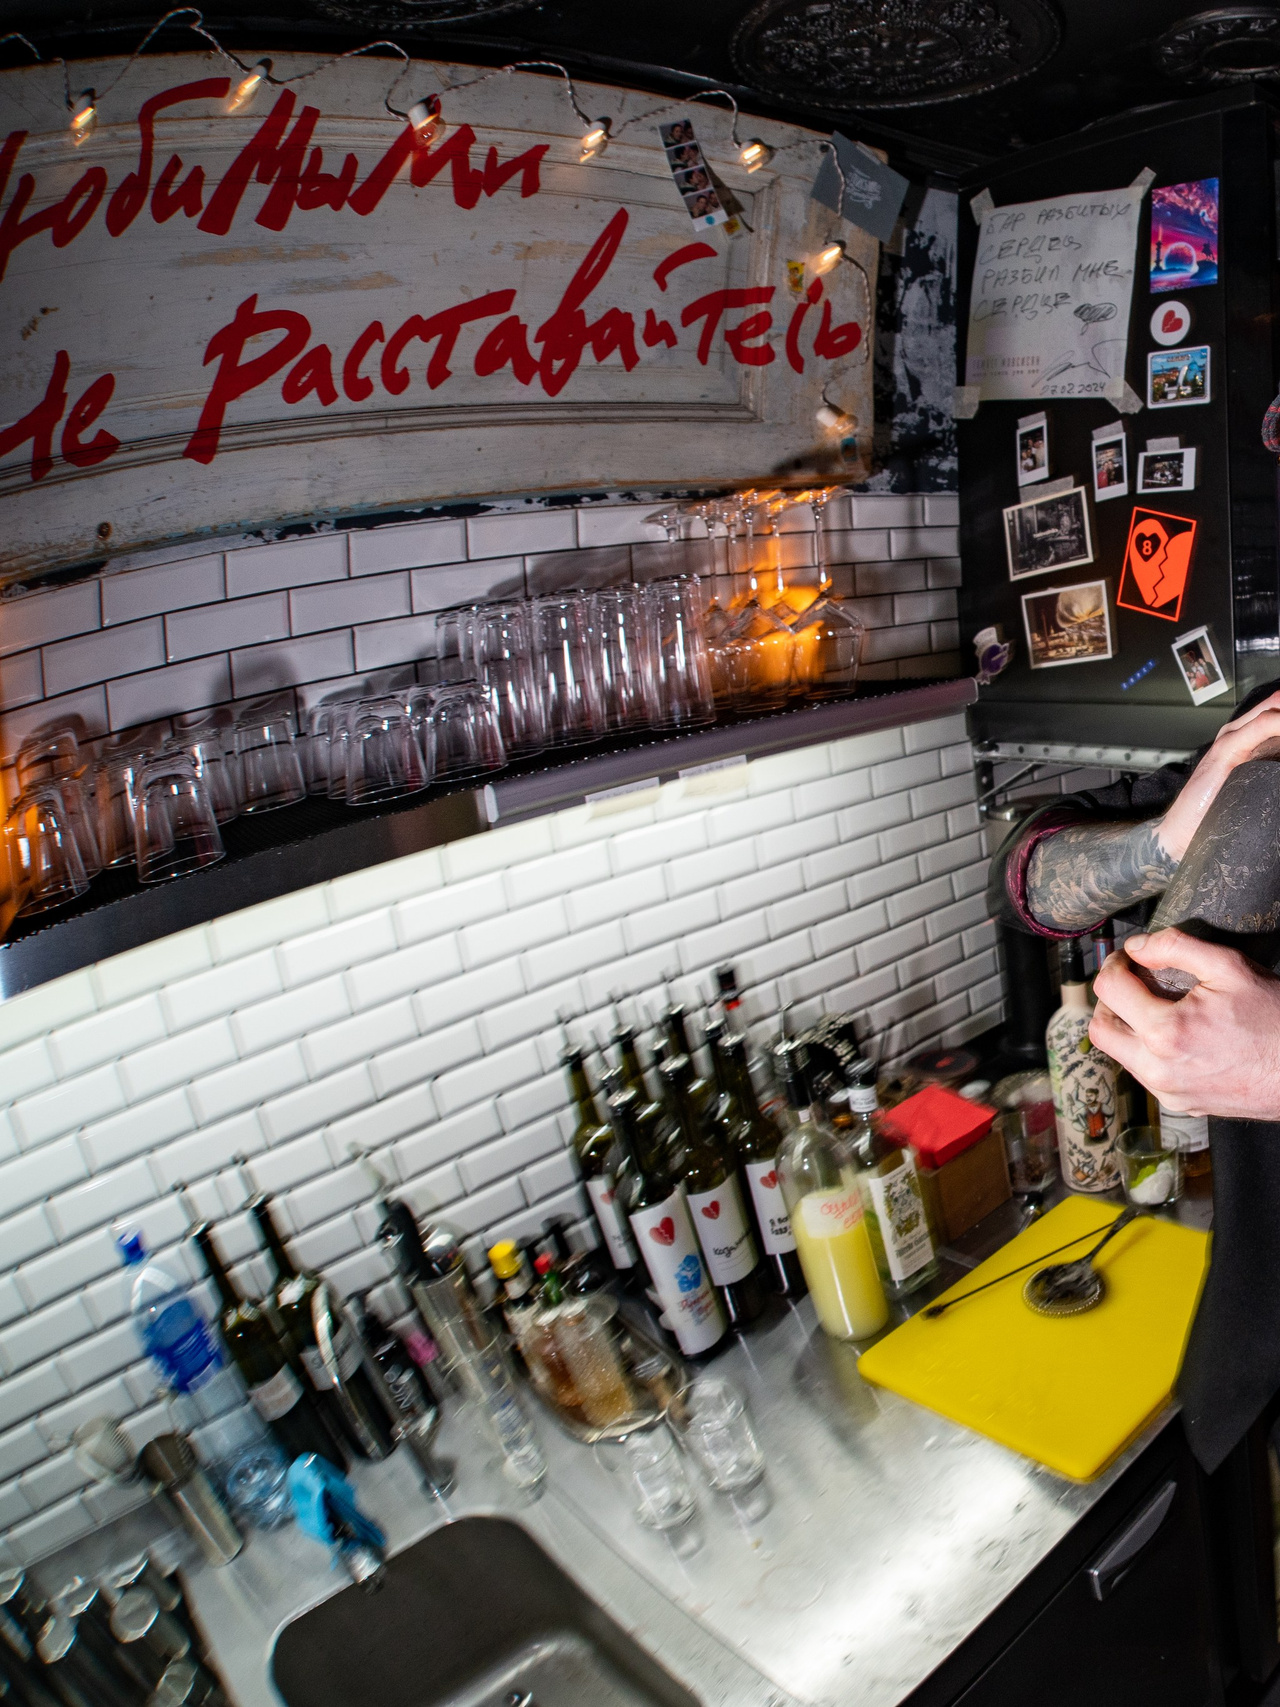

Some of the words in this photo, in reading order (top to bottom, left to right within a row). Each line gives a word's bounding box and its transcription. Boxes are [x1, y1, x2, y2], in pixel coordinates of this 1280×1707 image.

[986, 211, 1026, 235] БАР
[1036, 203, 1132, 226] РАЗБИТЫХ
[978, 235, 1082, 265] СЕРДЕЦ
[981, 264, 1060, 294] РАЗБИЛ
[973, 293, 1072, 322] СЕРДЦЕ
[1141, 540, 1152, 556] 8
